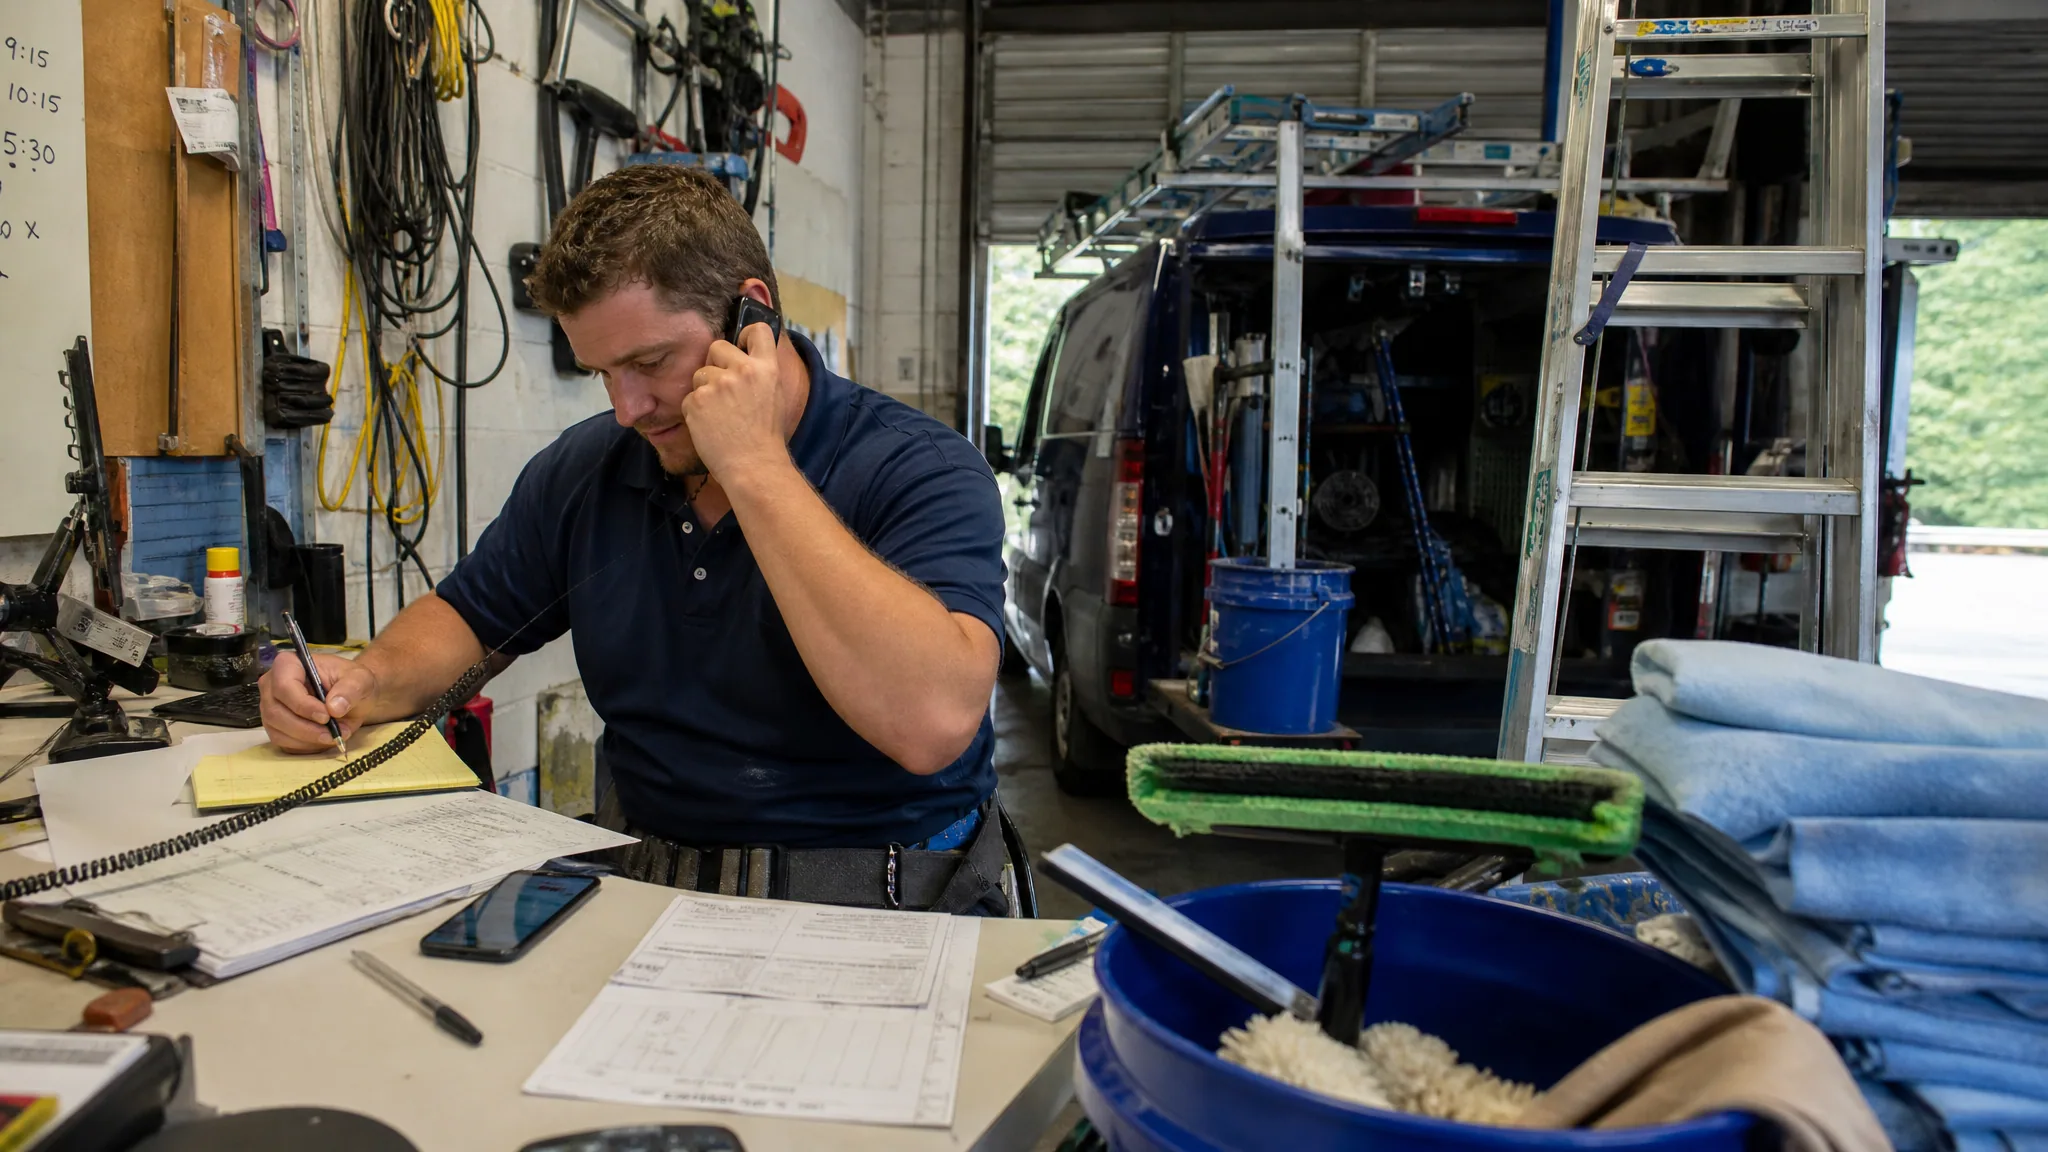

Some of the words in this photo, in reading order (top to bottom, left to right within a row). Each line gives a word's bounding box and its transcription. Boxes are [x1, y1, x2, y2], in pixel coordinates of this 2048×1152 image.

[5, 37, 49, 68] 9:15
[8, 83, 62, 113] 10:15
[3, 131, 56, 164] 5:30
